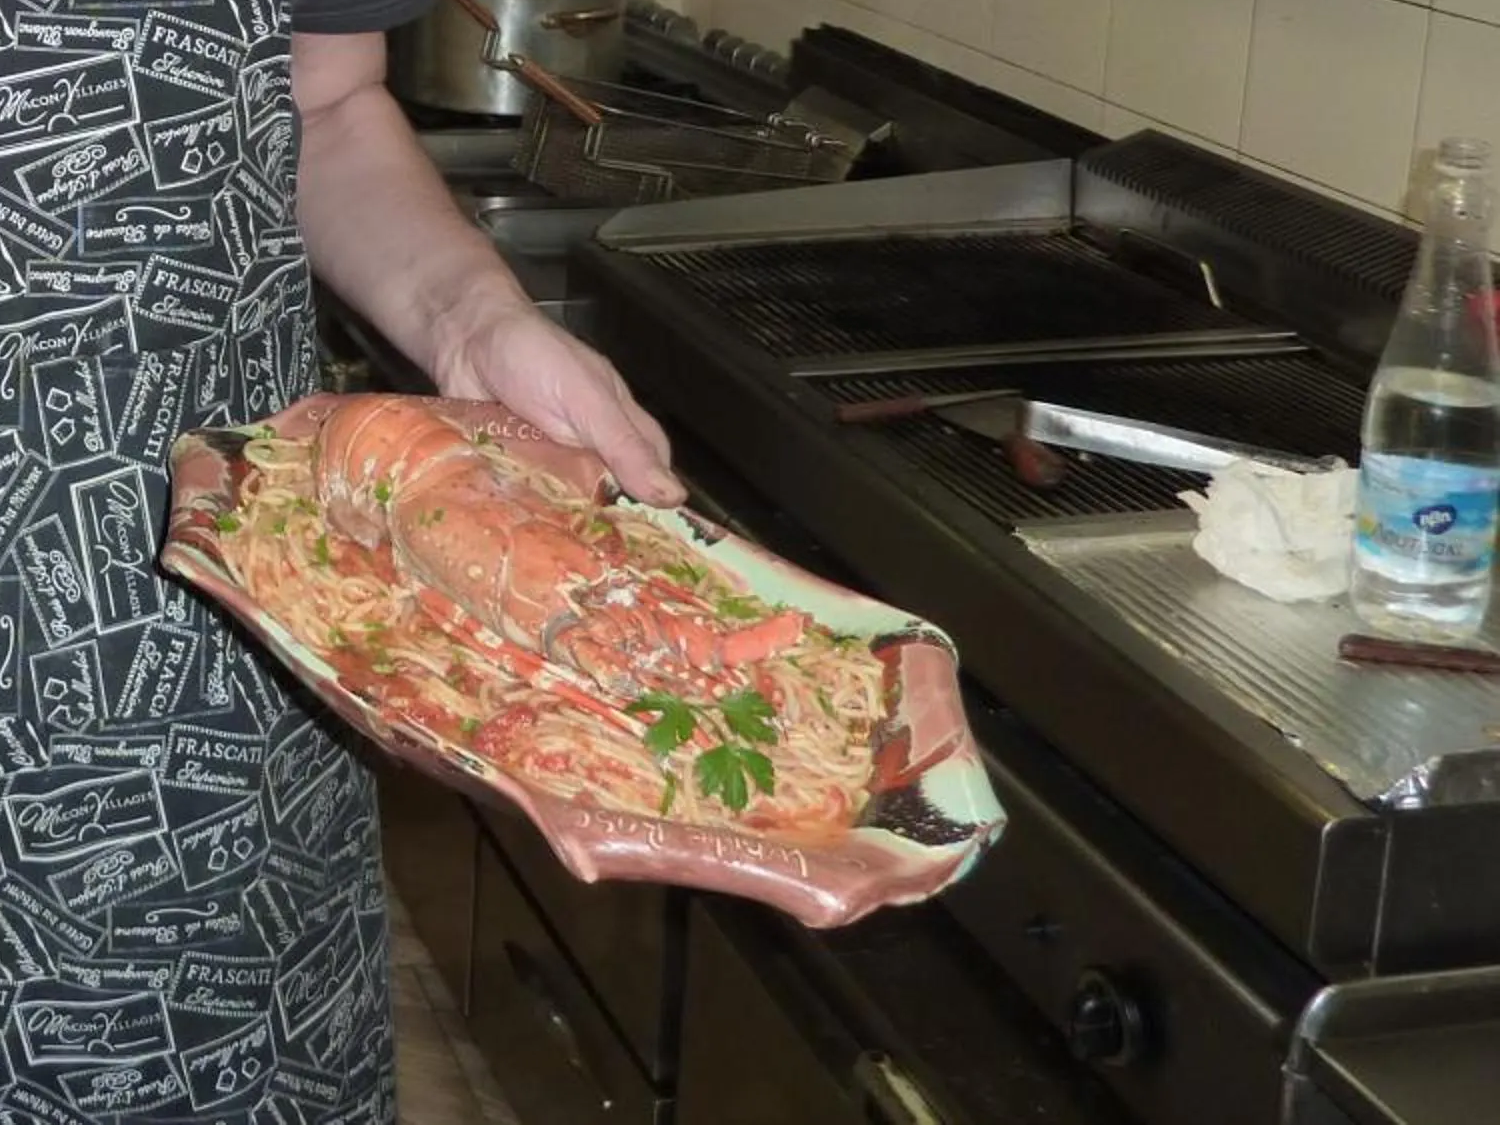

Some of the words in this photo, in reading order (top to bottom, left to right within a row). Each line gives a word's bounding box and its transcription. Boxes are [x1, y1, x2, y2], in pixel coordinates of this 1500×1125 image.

[152, 269, 235, 303] FRASCATI
[143, 350, 185, 458] FRASCATI
[150, 639, 185, 717] FRASCA
[176, 736, 263, 764] FRASCATI
[188, 965, 271, 985] FRASCATI
